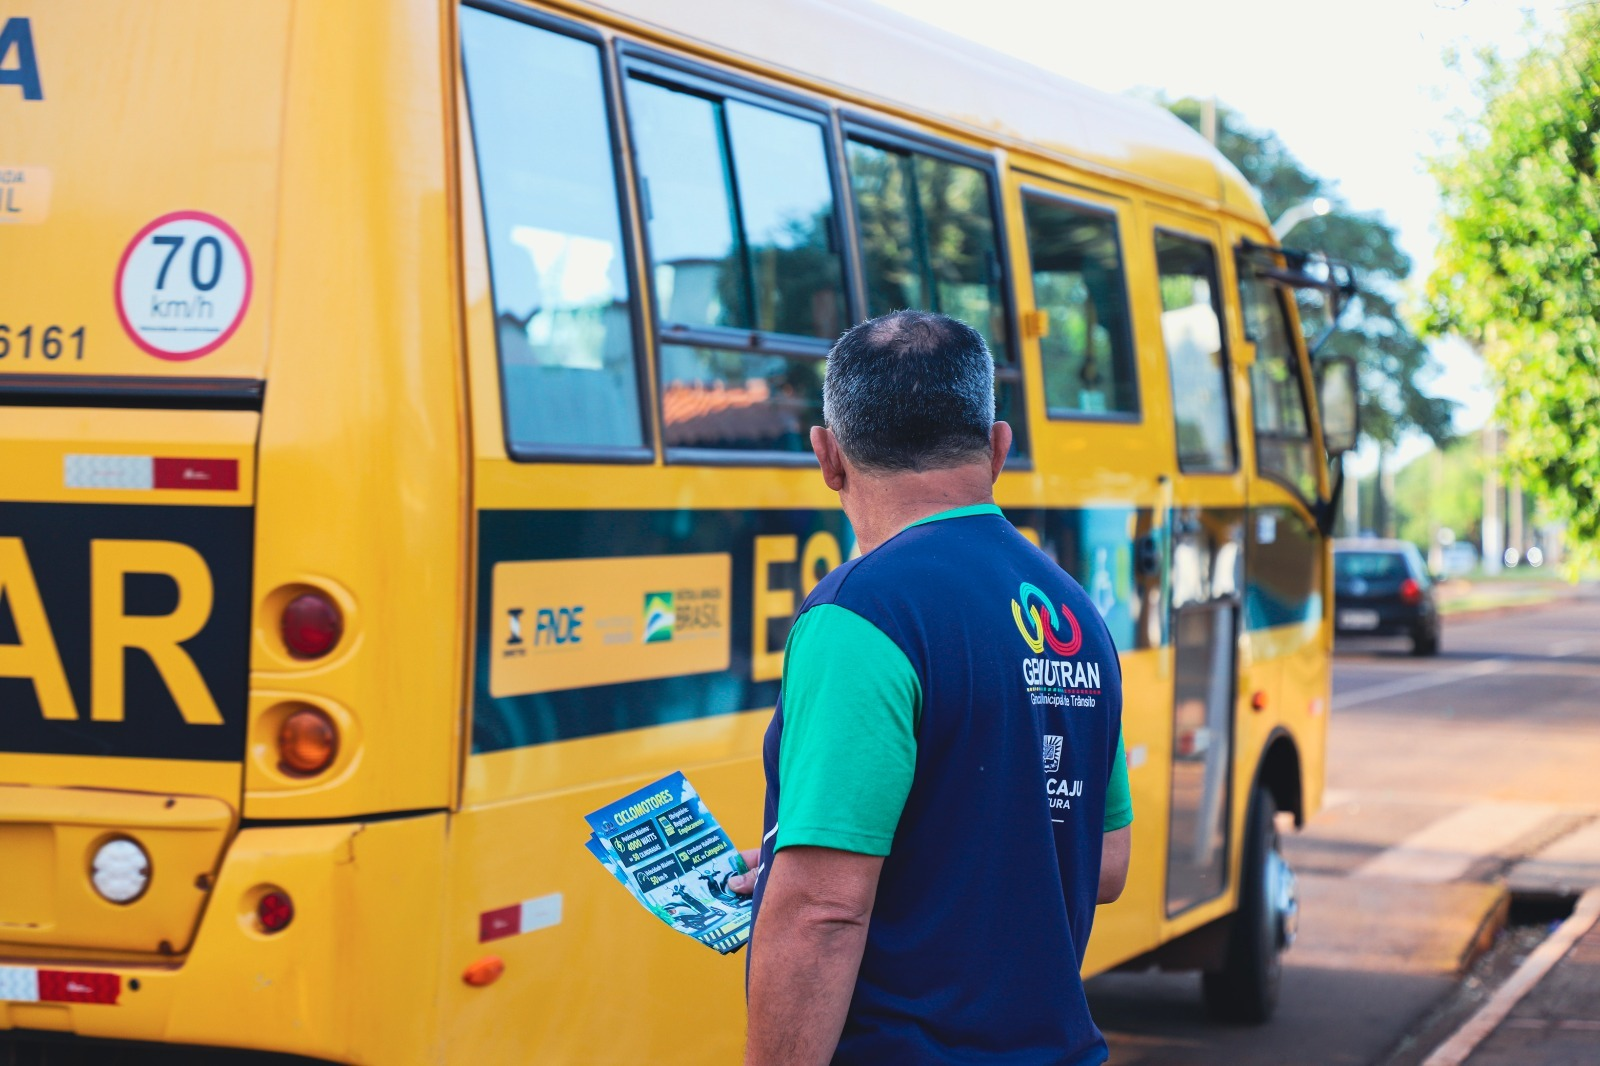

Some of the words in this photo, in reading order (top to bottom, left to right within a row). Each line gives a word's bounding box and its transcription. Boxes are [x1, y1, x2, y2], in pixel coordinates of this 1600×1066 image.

[152, 235, 223, 291] 70
[151, 295, 215, 319] km/h
[1070, 695, 1096, 708] Trânsito
[1046, 778, 1083, 797] CAJU
[613, 789, 674, 826] CICLOMOTORES
[627, 838, 643, 852] 4000
[640, 832, 658, 846] WATTS
